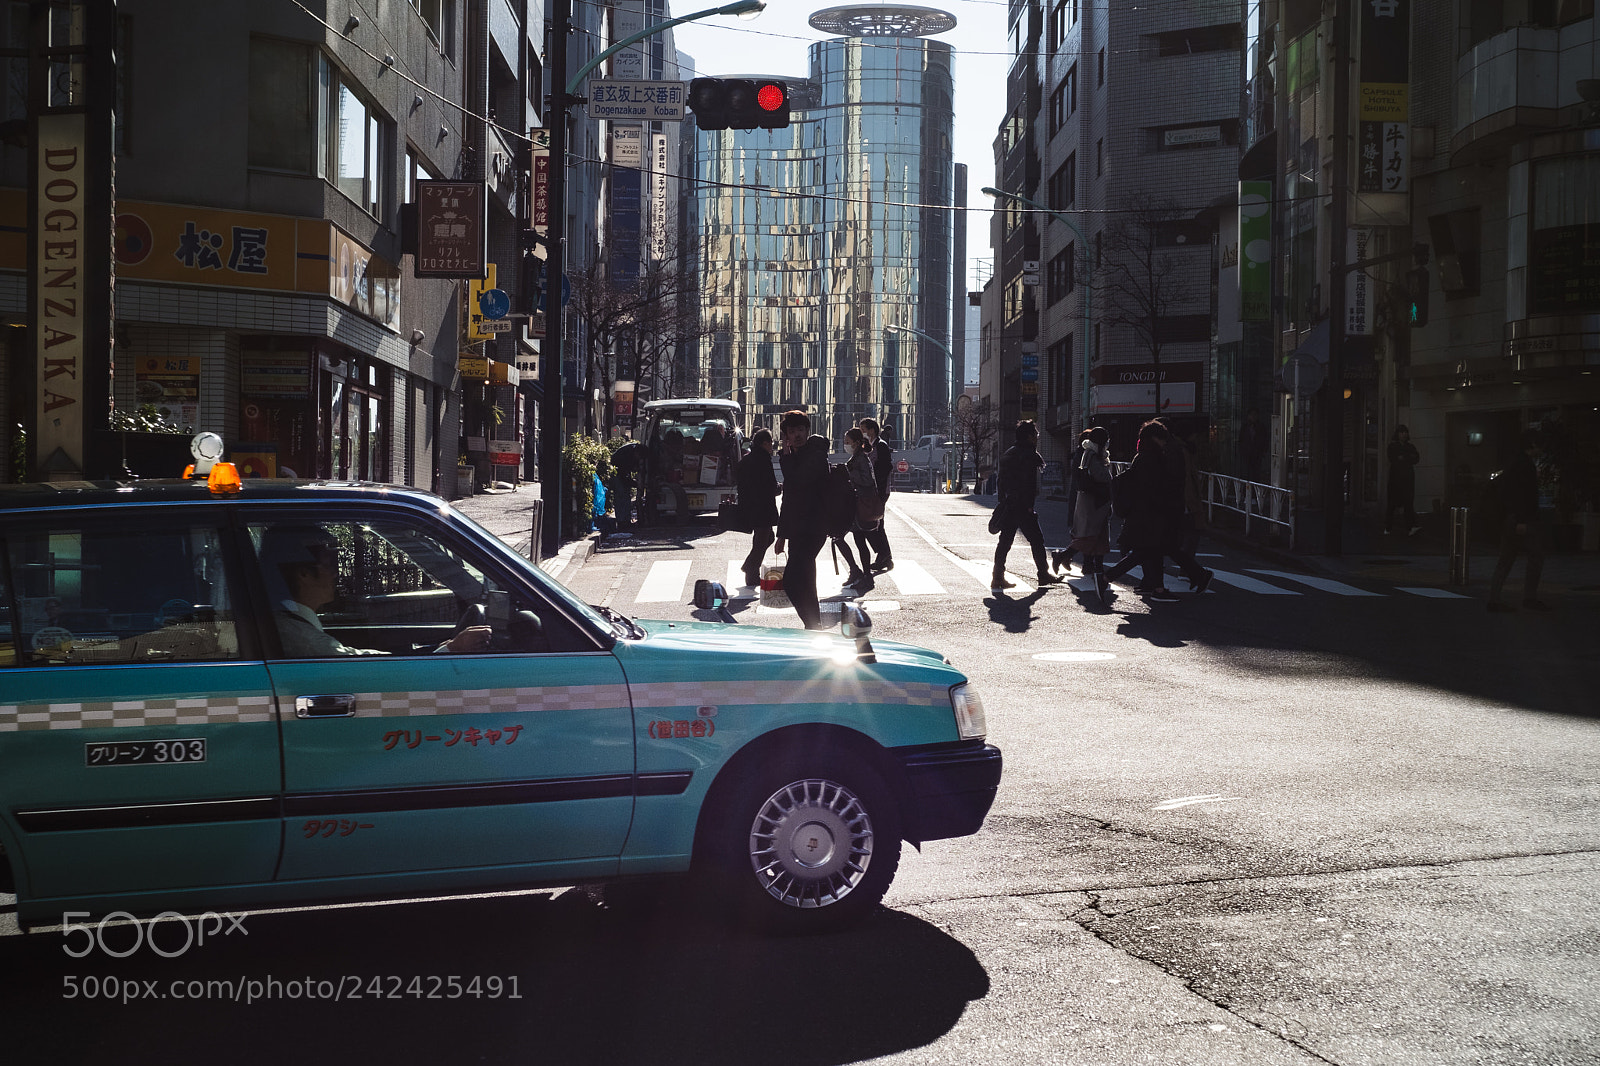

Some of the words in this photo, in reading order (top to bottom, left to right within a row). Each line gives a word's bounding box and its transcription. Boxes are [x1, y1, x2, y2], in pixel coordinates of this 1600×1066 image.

[592, 85, 682, 103] 道玄坂上交番前
[1362, 88, 1403, 97] CAPSULE
[1368, 96, 1397, 105] HOTEL
[595, 104, 647, 117] Dogenzakaue
[653, 106, 678, 116] Koban
[1363, 105, 1402, 113] SHIBUYA
[1384, 124, 1405, 190] 牛カツ
[173, 221, 270, 275] 松屋
[44, 146, 79, 413] DOGENZAKA
[482, 323, 510, 332] 歩行者優先
[165, 360, 189, 371] 松屋
[382, 724, 524, 750] グリーンキャブ
[648, 719, 715, 740] (世田谷)
[90, 746, 146, 763] グリーン
[153, 740, 204, 762] 303
[302, 819, 375, 838] タクシー
